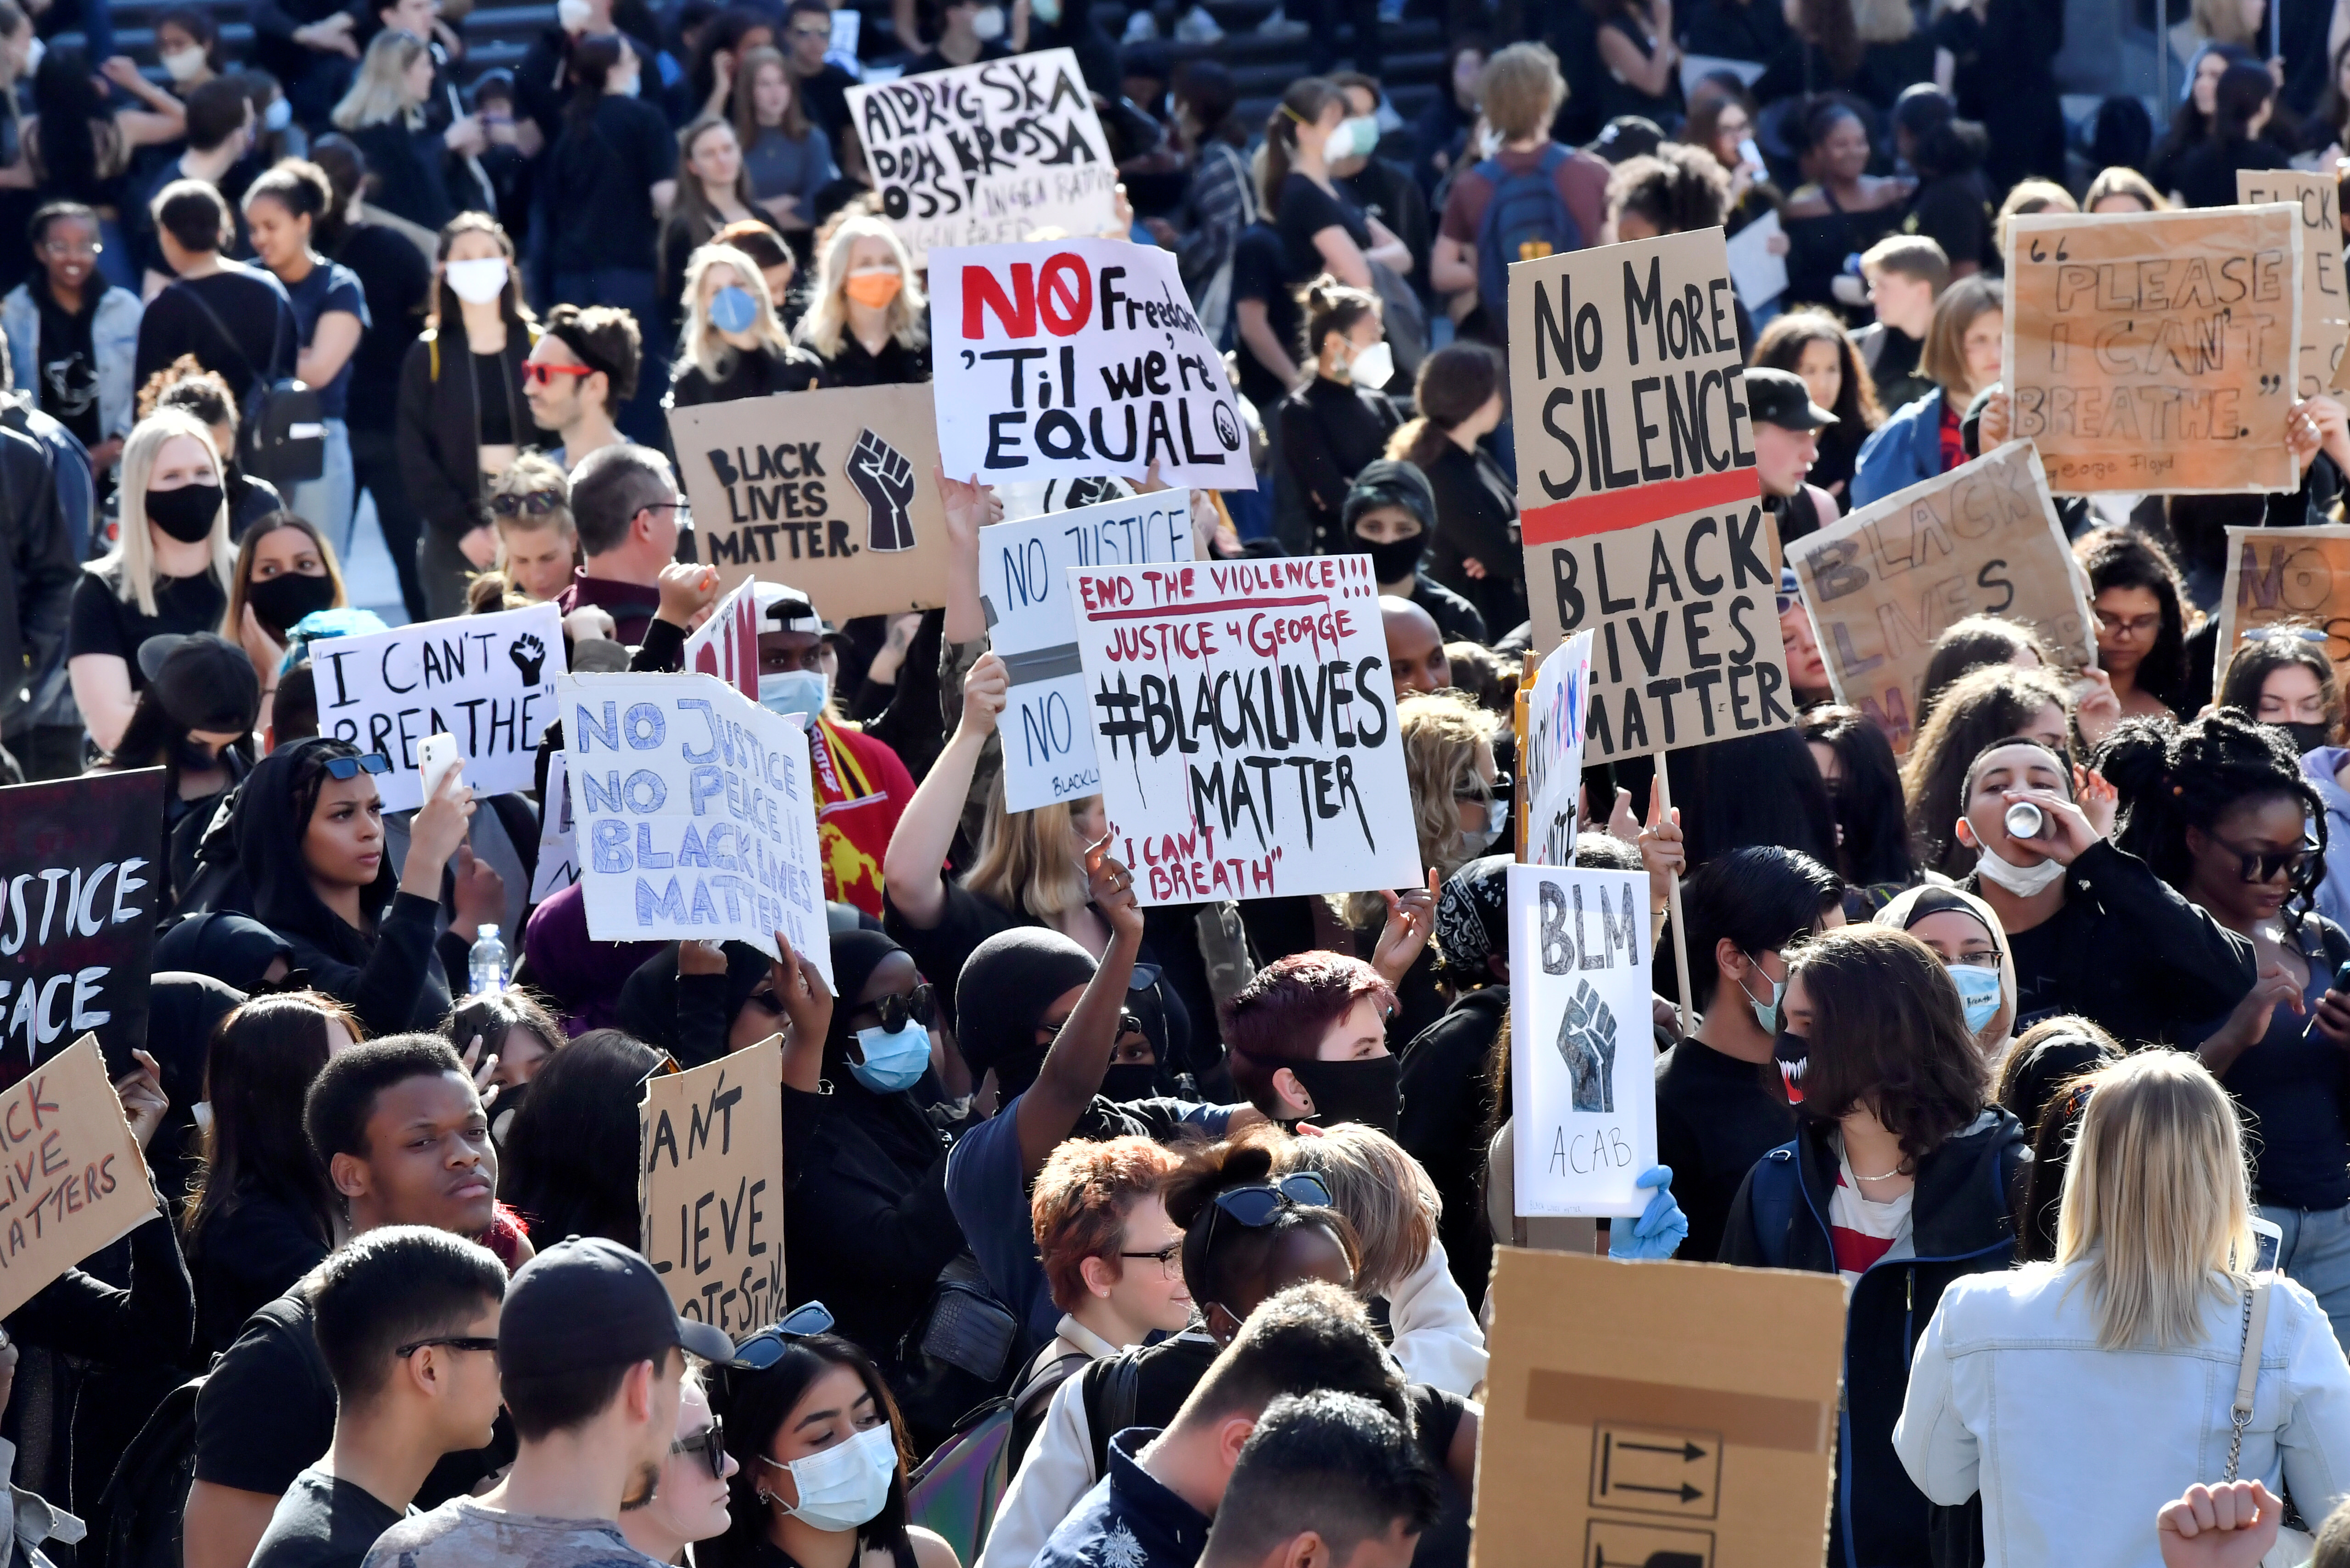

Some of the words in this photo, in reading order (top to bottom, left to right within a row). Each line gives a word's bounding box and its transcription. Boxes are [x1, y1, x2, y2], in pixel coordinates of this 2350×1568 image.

[865, 77, 985, 144] ALDRIG
[979, 63, 1087, 114] SKA
[873, 138, 946, 180] DOM
[946, 116, 1099, 175] KROSSA
[883, 176, 978, 224] OSS!
[962, 252, 1093, 340] NO
[1100, 266, 1203, 337] Freedom
[1534, 274, 1603, 380] NO
[1623, 256, 1735, 366] MORE
[960, 345, 1076, 409] 'Til
[1100, 332, 1217, 401] we're
[2050, 323, 2069, 373] I
[707, 442, 826, 488] BLACK
[984, 398, 1225, 470] EQUAL
[1539, 364, 1757, 500] SILENCE
[727, 481, 828, 524] LIVES
[1805, 462, 2031, 602] BLACK
[708, 520, 860, 566] MATTER.
[1003, 538, 1048, 611] NO
[1552, 505, 1774, 630] BLACK
[2237, 543, 2334, 612] NO
[1080, 576, 1134, 610] END
[1142, 567, 1195, 605] THE
[1210, 557, 1371, 599] VIOLENCE!!!
[1832, 559, 2014, 678] LIVES
[381, 631, 498, 694] CAN'T
[1106, 621, 1219, 661] JUSTICE
[1226, 620, 1242, 646] 4
[1248, 610, 1358, 662] GEORGE
[1022, 691, 1071, 767] NO
[1095, 656, 1388, 763] #BLACKLIVES
[1550, 660, 1588, 767] TRANS
[576, 701, 666, 754] NO
[677, 699, 798, 802] JUSTICE
[582, 769, 667, 816] NO
[1189, 754, 1376, 856] MATTER
[592, 819, 754, 879] BLACK
[756, 838, 813, 914] LIVES
[1539, 880, 1638, 976] BLM
[0, 1076, 59, 1153] CK
[1549, 1125, 1632, 1178] ACAB
[0, 1153, 117, 1269] ATTERS
